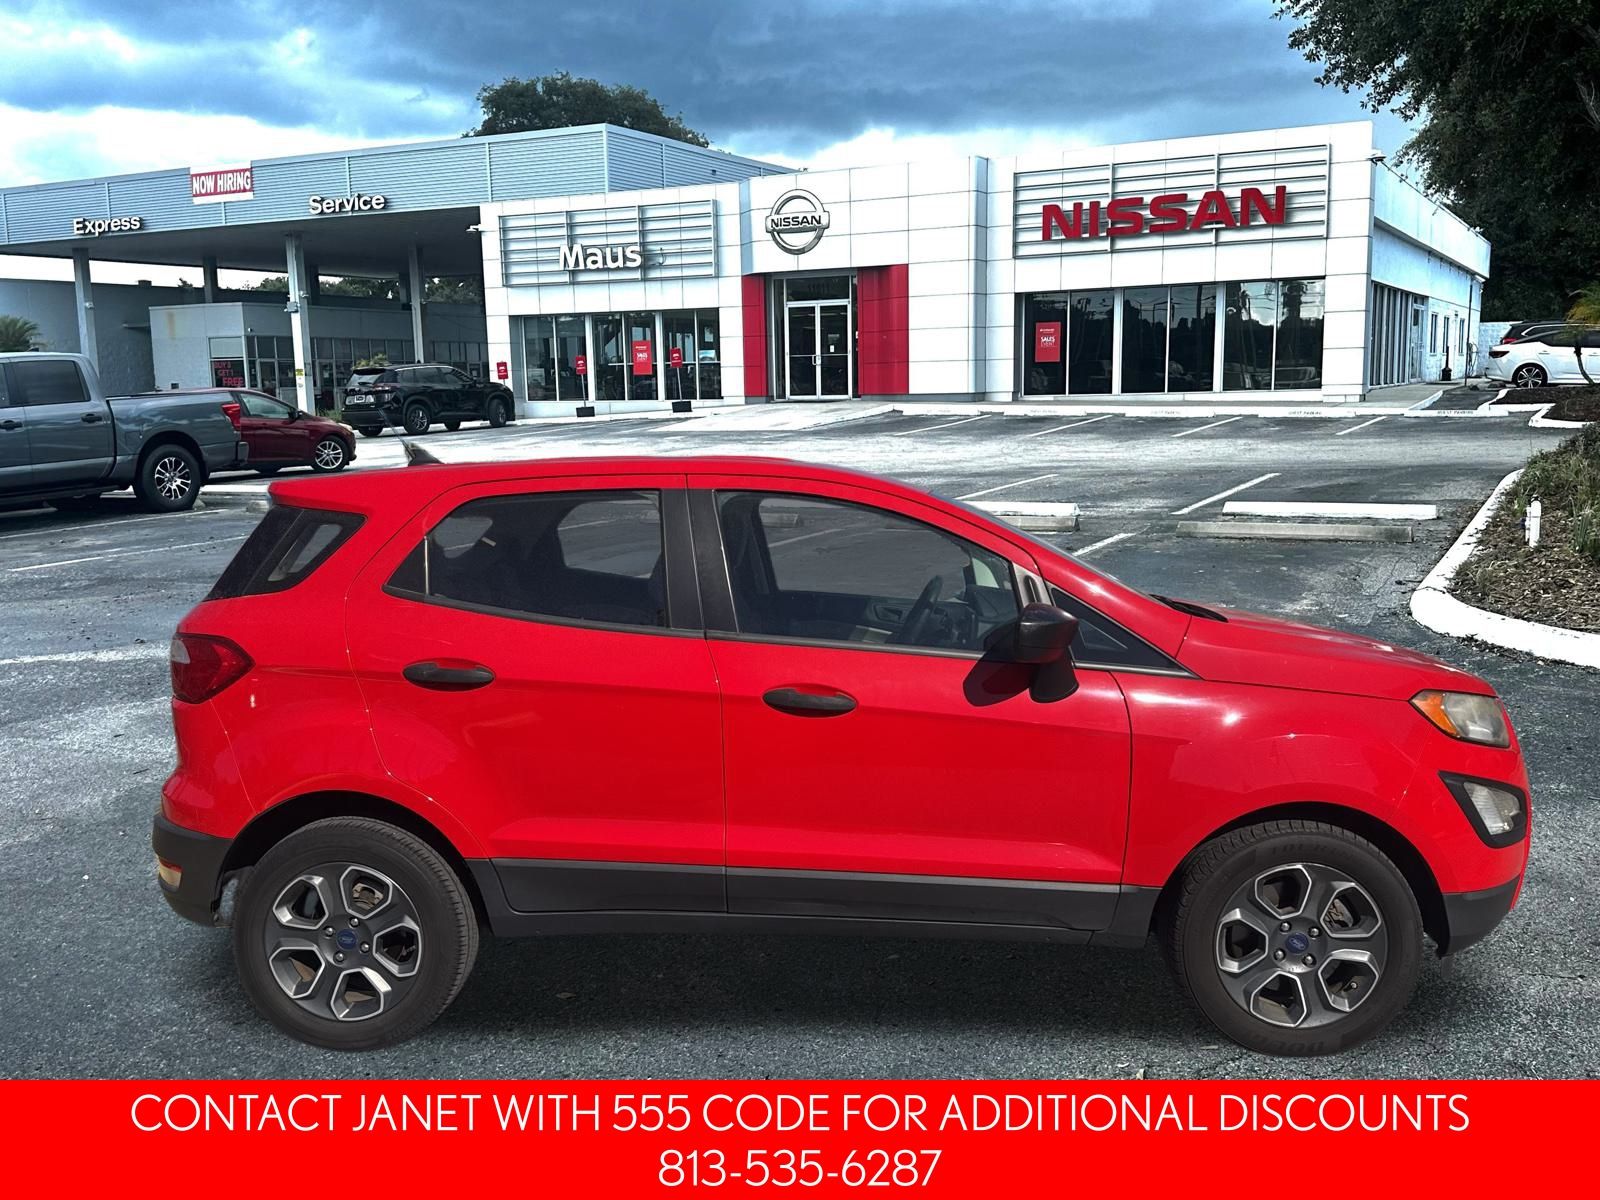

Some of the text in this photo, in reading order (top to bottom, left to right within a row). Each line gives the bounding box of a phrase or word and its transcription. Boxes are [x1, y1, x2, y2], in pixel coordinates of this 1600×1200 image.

[192, 171, 251, 195] NOW HIRING
[309, 193, 385, 215] Service
[1042, 185, 1287, 241] NISSAN
[73, 216, 141, 236] Express
[770, 215, 821, 228] NISSAN
[559, 243, 642, 270] Maus
[222, 377, 244, 387] FREE
